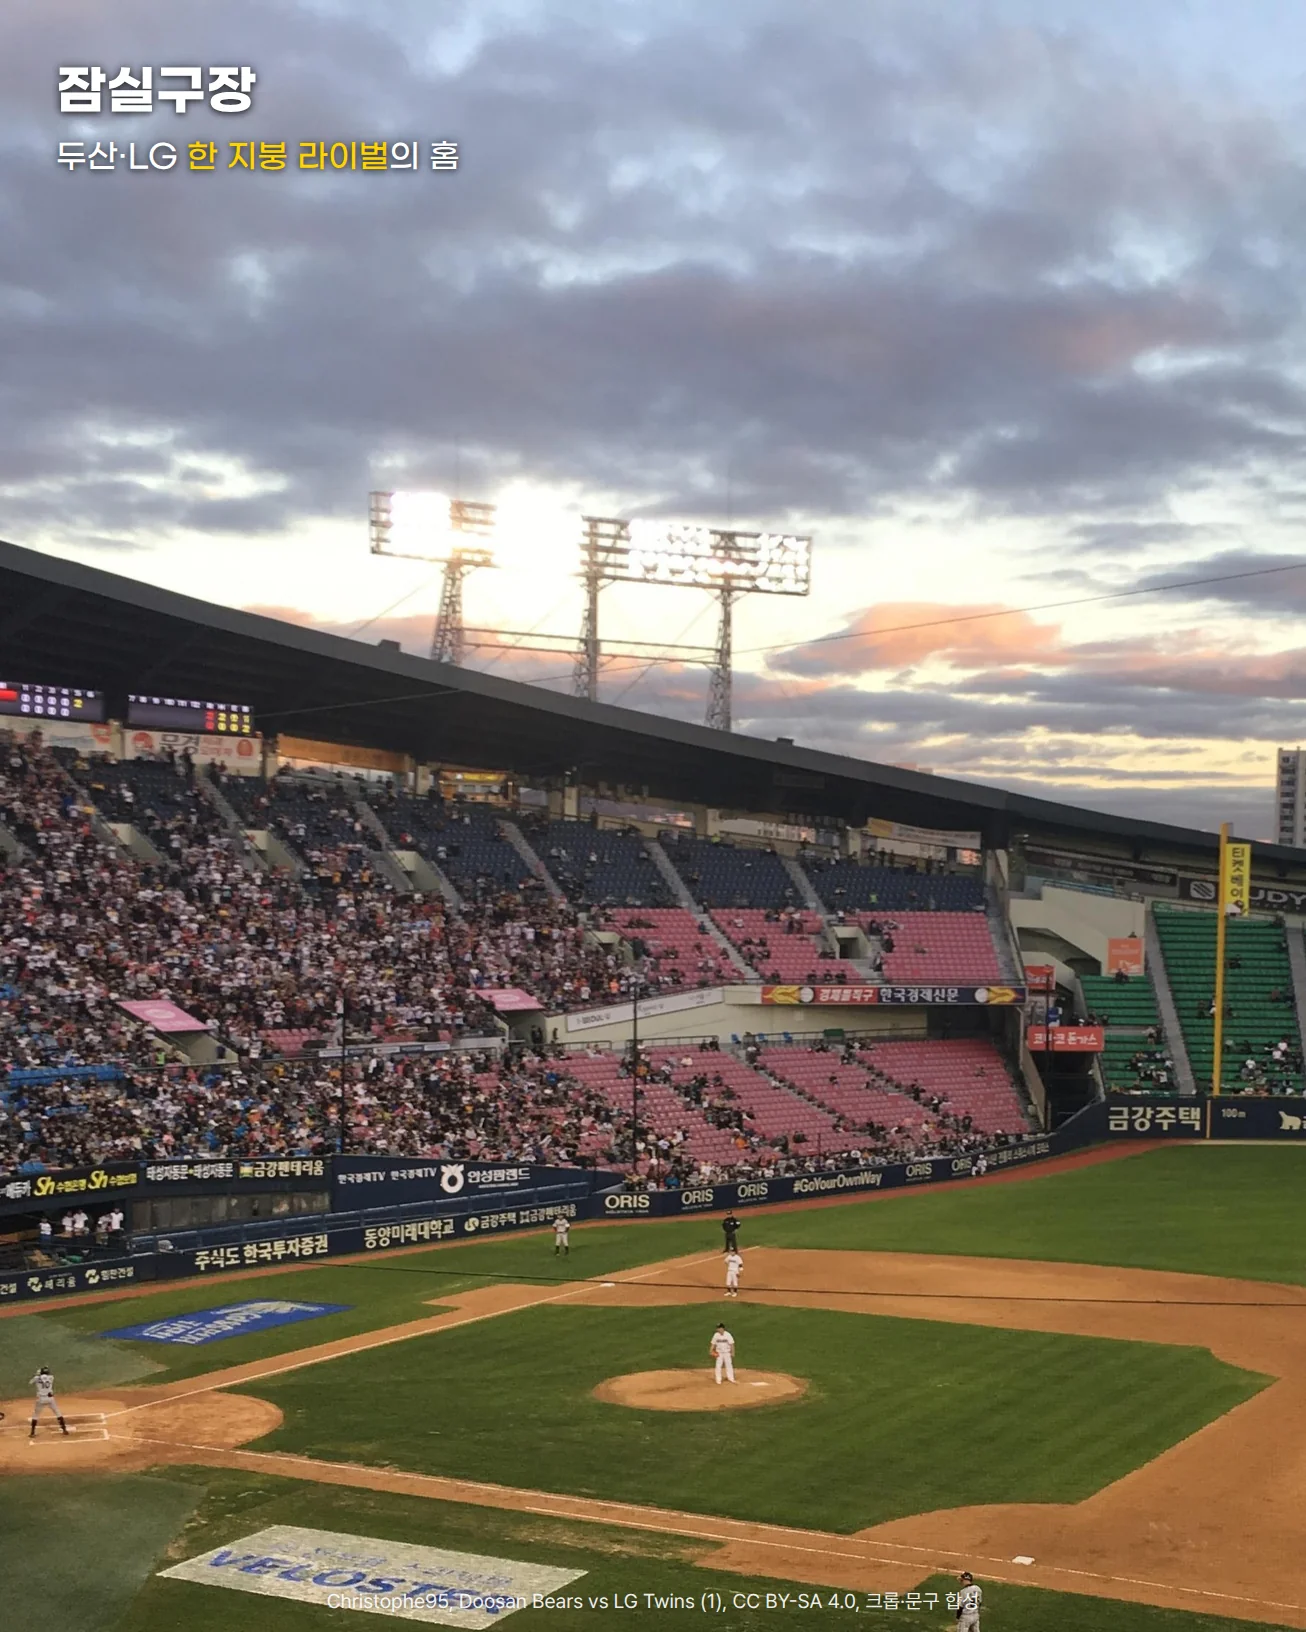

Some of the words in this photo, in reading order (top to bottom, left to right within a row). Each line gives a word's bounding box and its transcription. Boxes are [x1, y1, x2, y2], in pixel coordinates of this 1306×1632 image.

[880, 988, 960, 1003] 한국경제신문
[1108, 1106, 1201, 1132] 금강주택
[254, 1160, 325, 1177] 금강펜테리움
[467, 1167, 531, 1184] 안성팜랜드
[905, 1162, 933, 1179] ORIS
[34, 1176, 56, 1196] Sh
[88, 1170, 109, 1189] Sh
[793, 1171, 883, 1195] #GoYourOwnWay
[681, 1188, 714, 1205] ORIS
[737, 1182, 769, 1198] ORIS
[605, 1194, 650, 1209] ORIS
[480, 1211, 517, 1229] 금강주택
[364, 1218, 456, 1249] 동양미래대학교
[195, 1246, 241, 1271] 주식도
[243, 1234, 329, 1265] 한국투자증권
